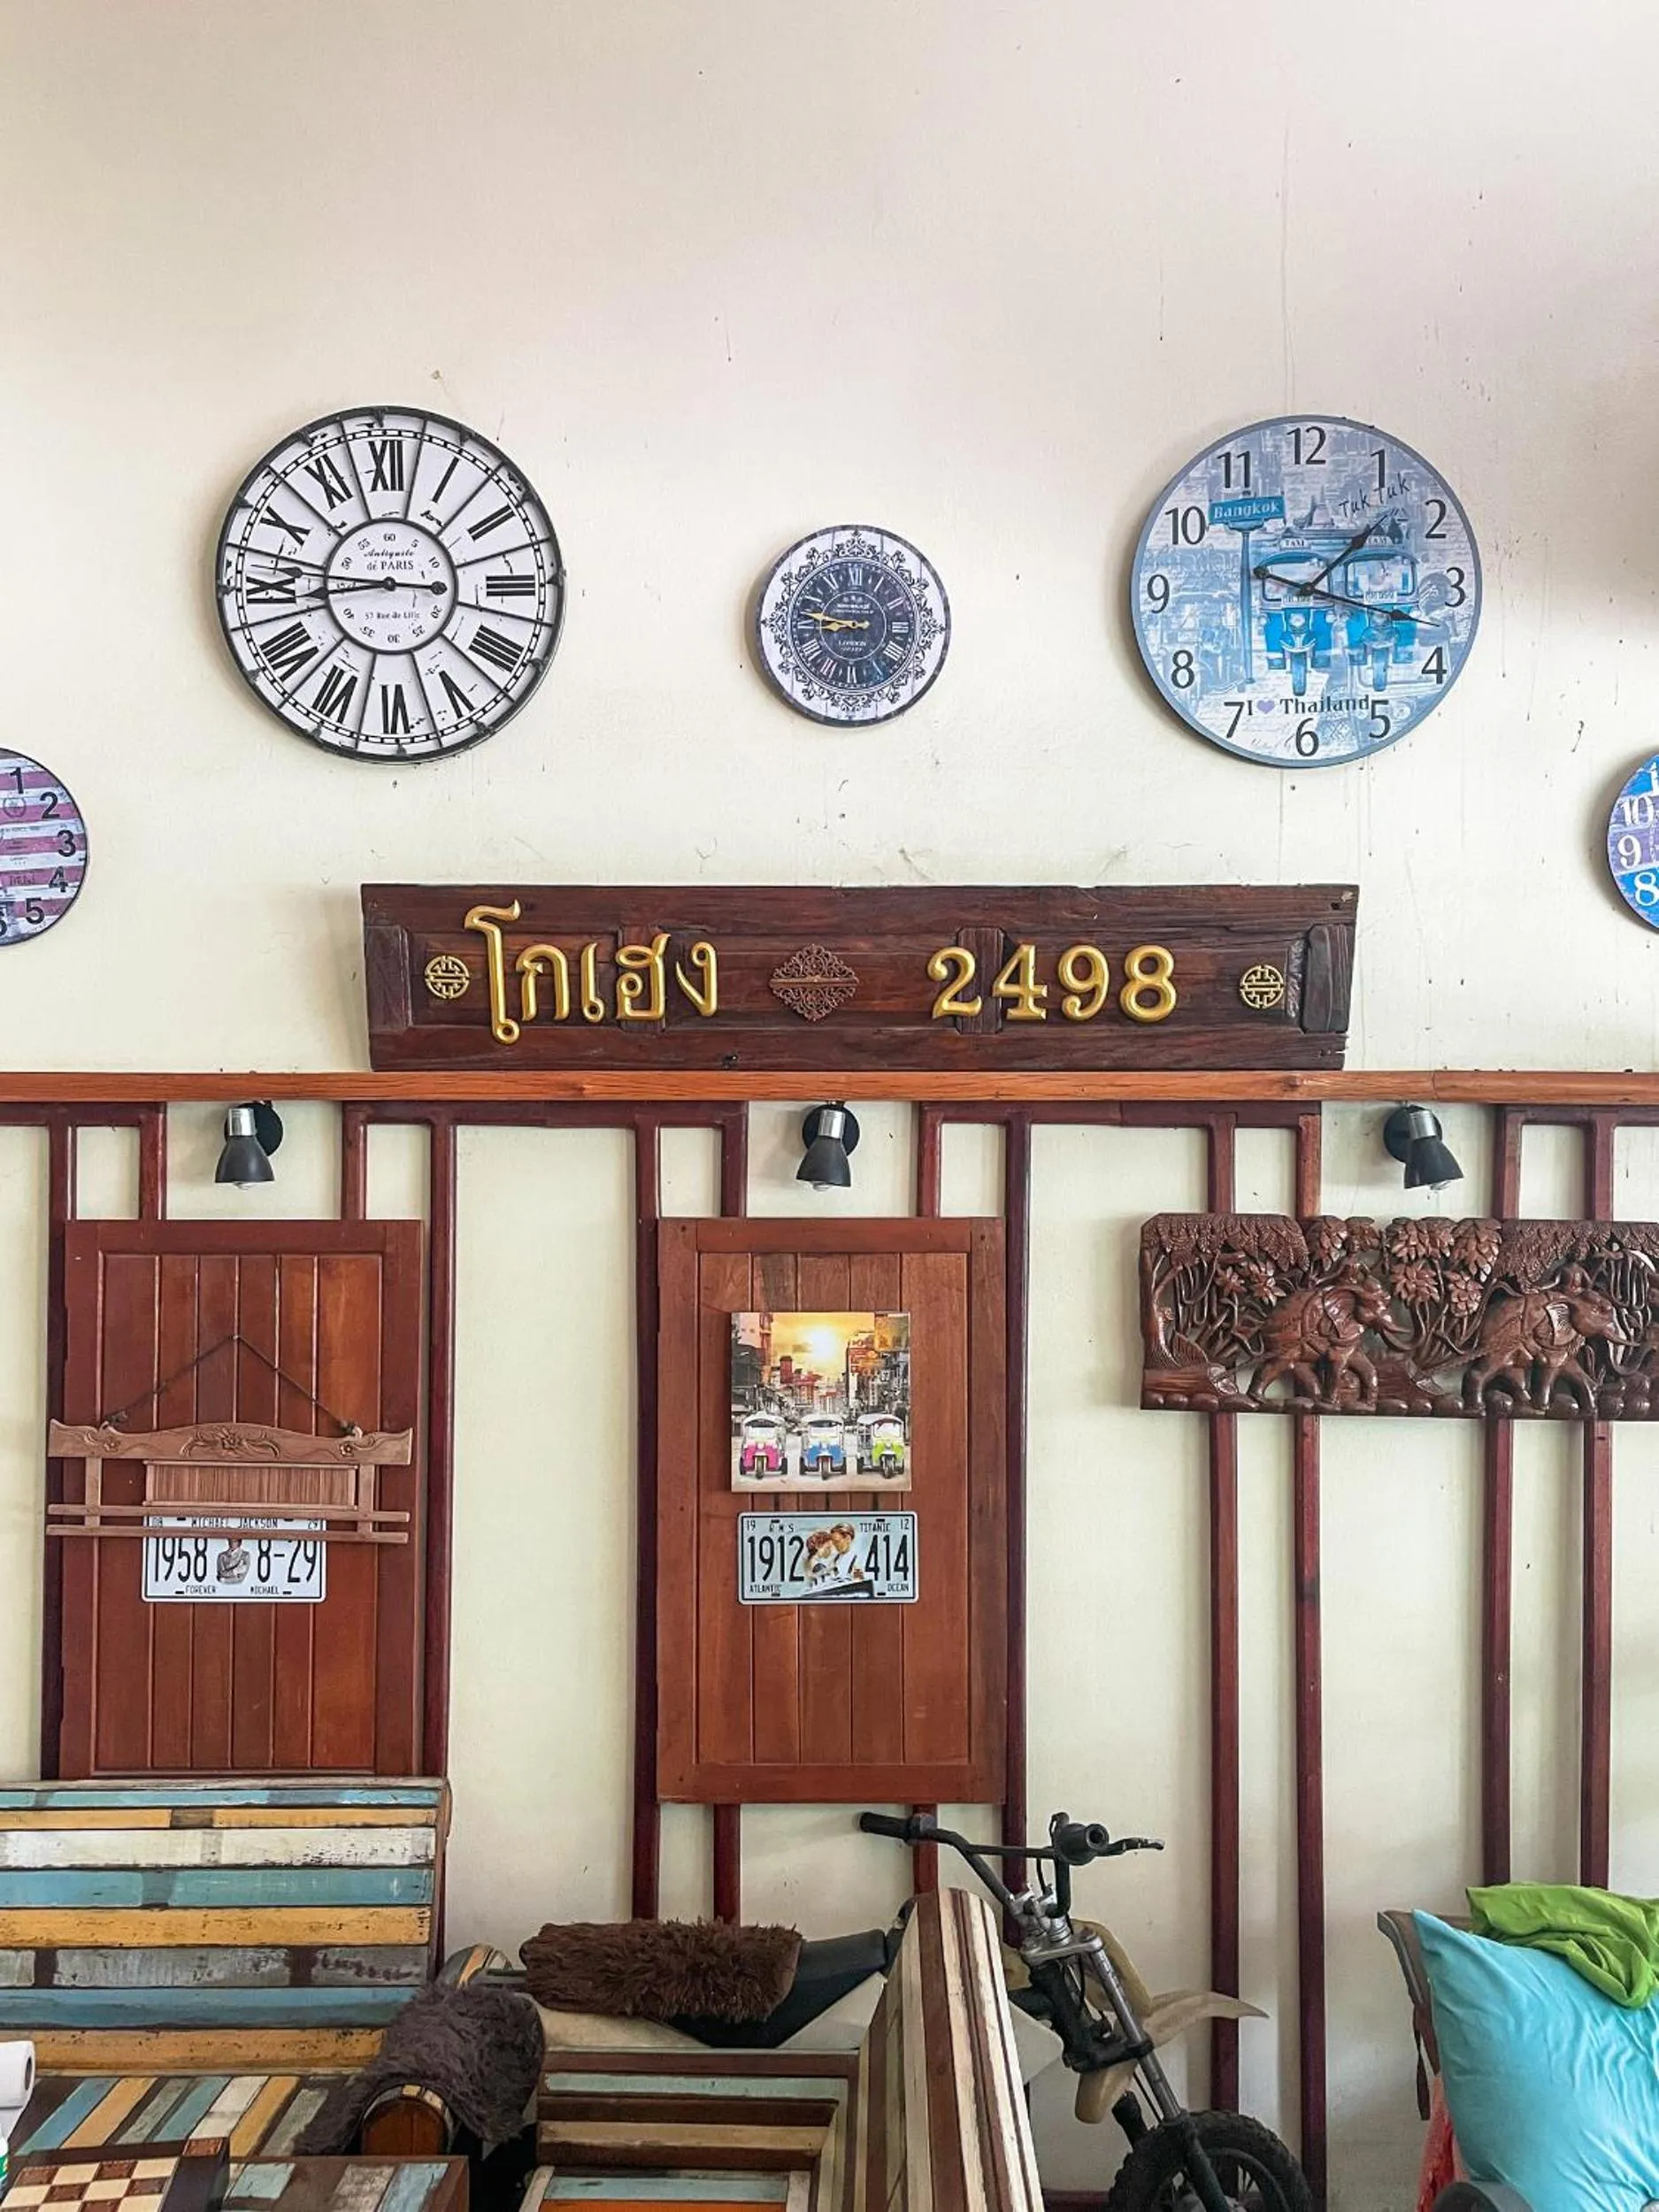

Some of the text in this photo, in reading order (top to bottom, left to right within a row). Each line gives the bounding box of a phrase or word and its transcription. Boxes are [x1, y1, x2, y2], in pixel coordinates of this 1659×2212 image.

[1286, 426, 1327, 465] 12
[303, 453, 353, 511] XI
[368, 440, 403, 491] XII
[1217, 450, 1251, 488] 11
[1371, 449, 1386, 488] 1
[1214, 500, 1280, 518] Bangkok
[1339, 488, 1371, 518] Tuk
[1425, 499, 1448, 539] 2
[259, 505, 310, 546] X
[1164, 506, 1206, 545] 10
[380, 560, 413, 570] PARIS
[484, 574, 535, 596] III
[1148, 574, 1170, 613] 9
[1444, 567, 1465, 608] 3
[1171, 650, 1194, 689] 8
[1421, 647, 1448, 684] 4
[1224, 702, 1246, 739] 7
[1279, 695, 1370, 714] Thailand
[1369, 699, 1391, 739] 5
[1295, 718, 1319, 757] 6
[10, 767, 24, 794] 1
[39, 792, 60, 819] 2
[1619, 795, 1654, 827] 10
[57, 830, 76, 856] 3
[1617, 834, 1641, 869] 9
[49, 866, 68, 893] 4
[1634, 872, 1659, 906] 8
[26, 898, 44, 925] 5
[464, 899, 1177, 1045] โกเฮง 2498
[238, 1517, 278, 1529] JACKSON
[859, 1523, 891, 1532] TITANIC
[154, 1538, 317, 1583] 1958 8-29
[748, 1534, 910, 1582] 1912 414
